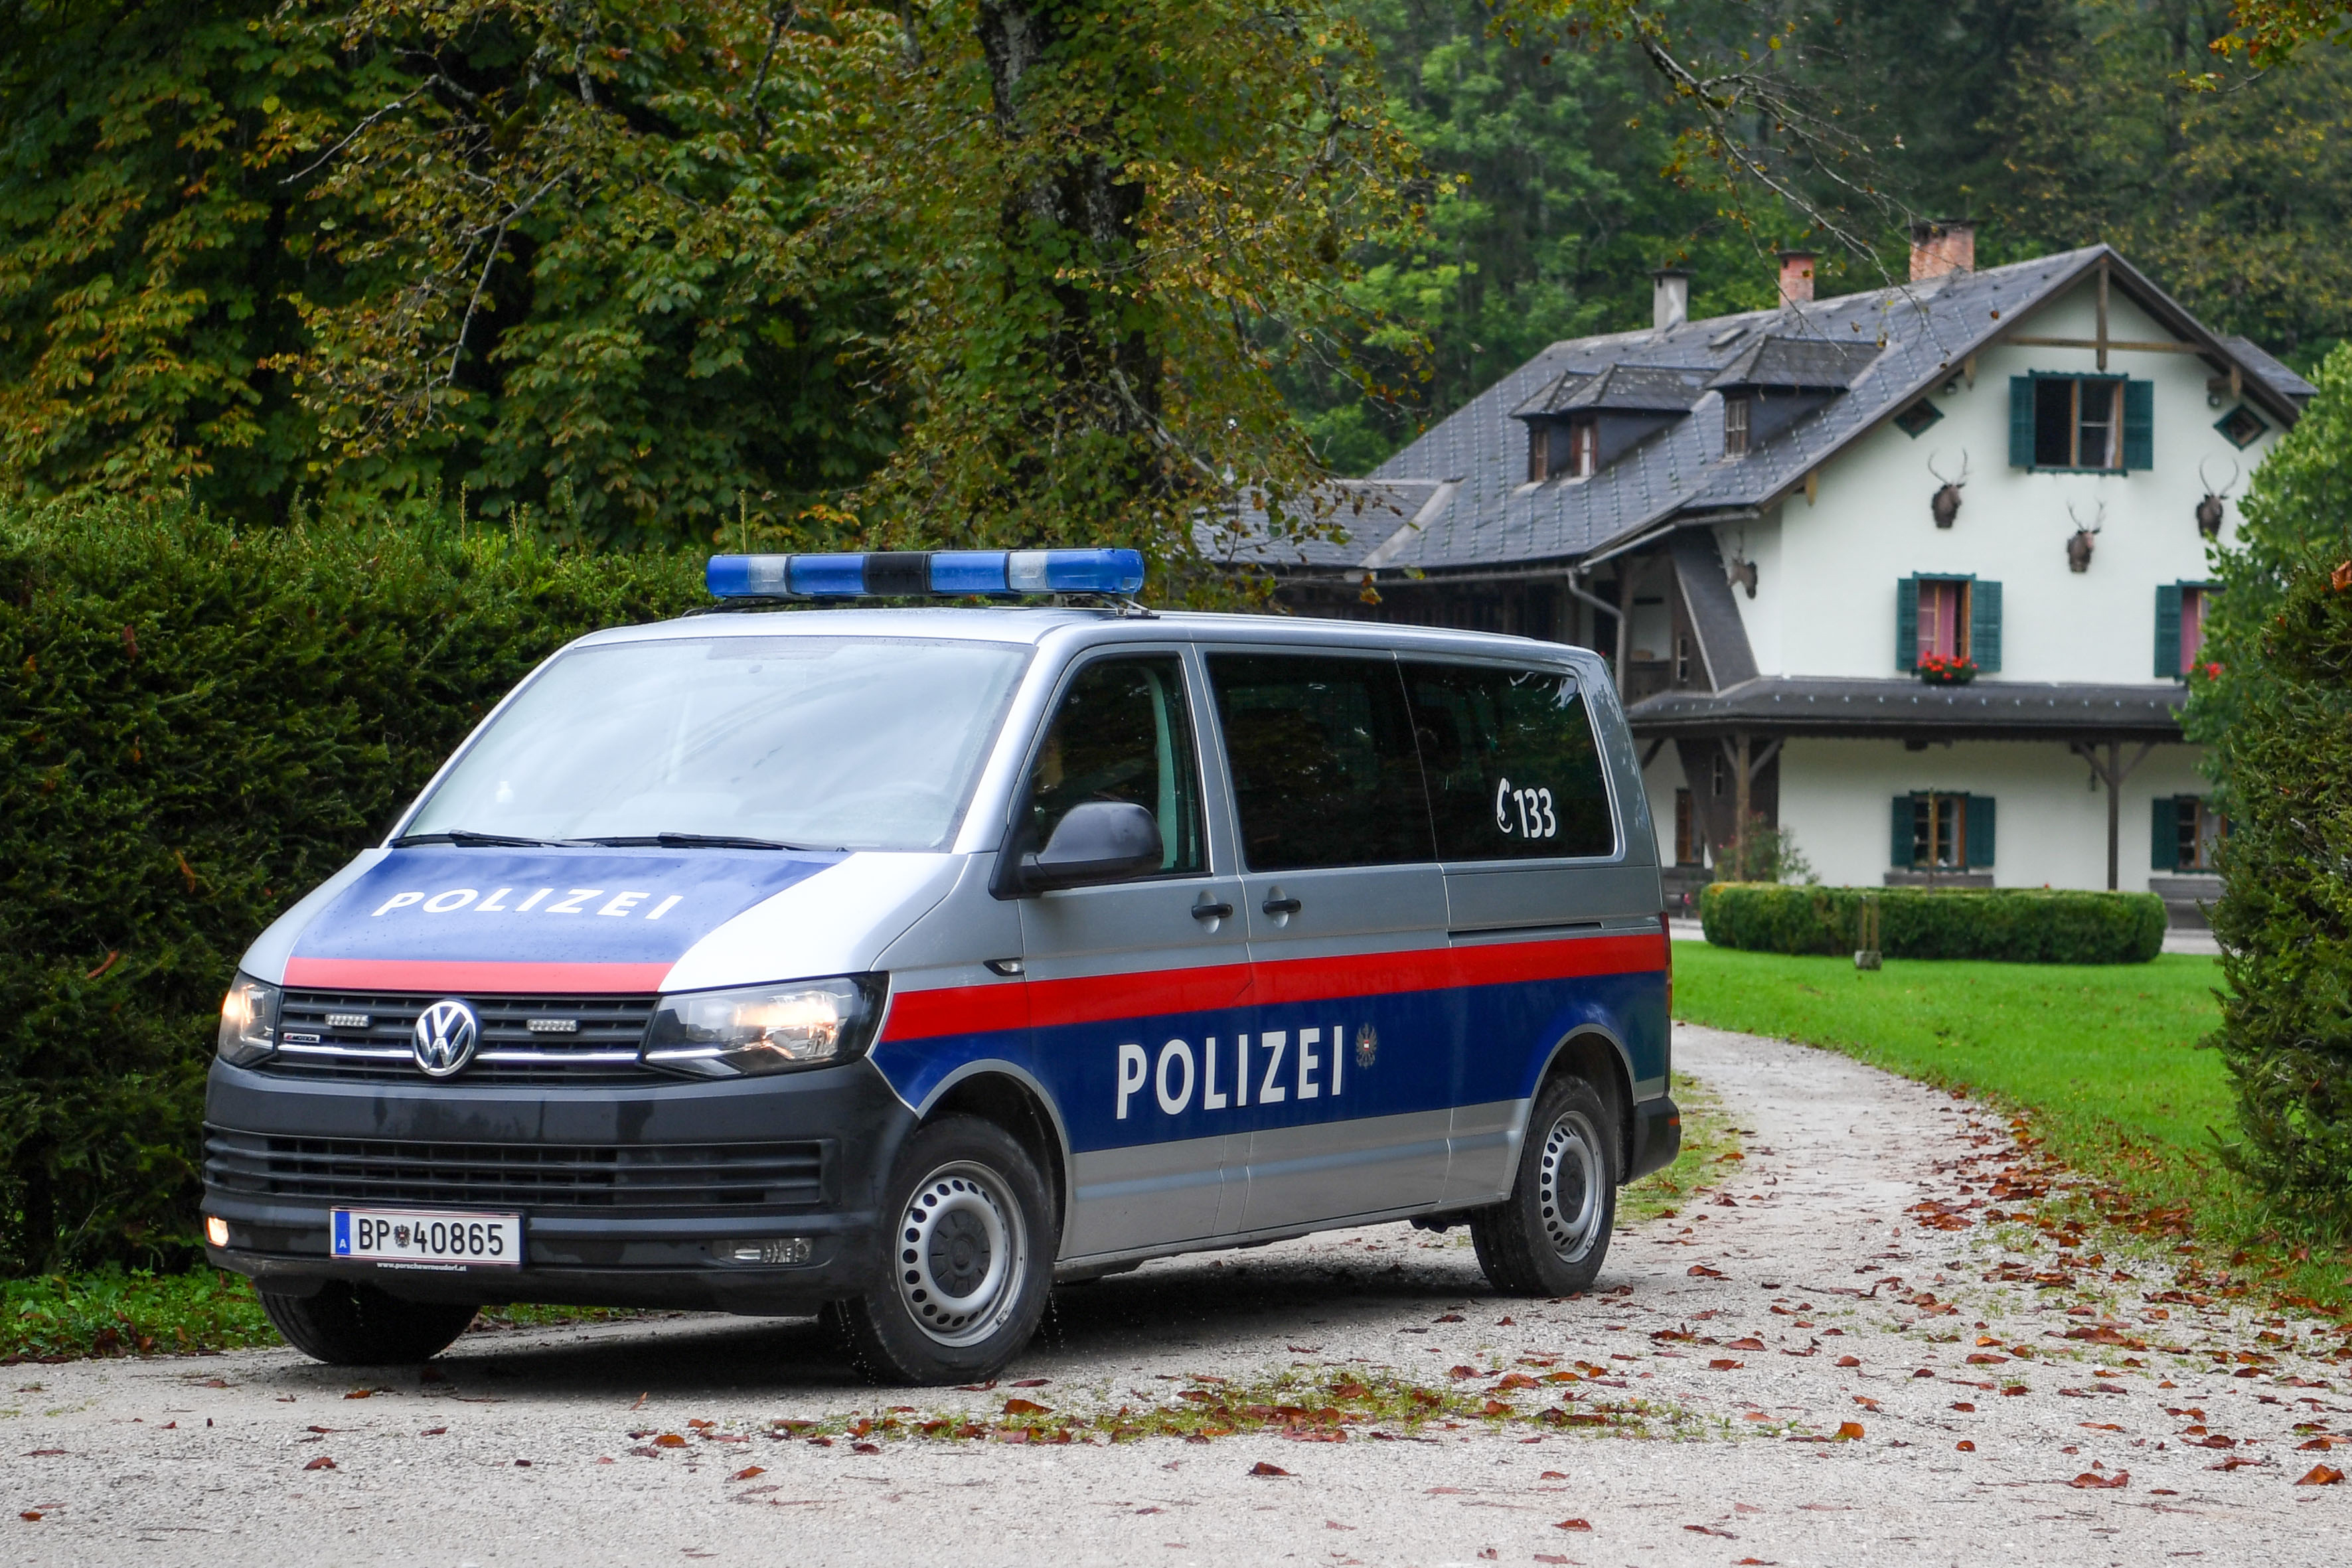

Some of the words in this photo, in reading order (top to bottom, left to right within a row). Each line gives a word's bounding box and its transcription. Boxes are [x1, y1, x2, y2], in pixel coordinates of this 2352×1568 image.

[1513, 787, 1556, 838] 133
[370, 888, 684, 920] POLIZEI
[415, 1002, 475, 1075] VW
[1116, 1025, 1343, 1120] POLIZEI
[339, 1239, 347, 1249] A
[358, 1218, 390, 1251] BP
[413, 1221, 504, 1255] 40865
